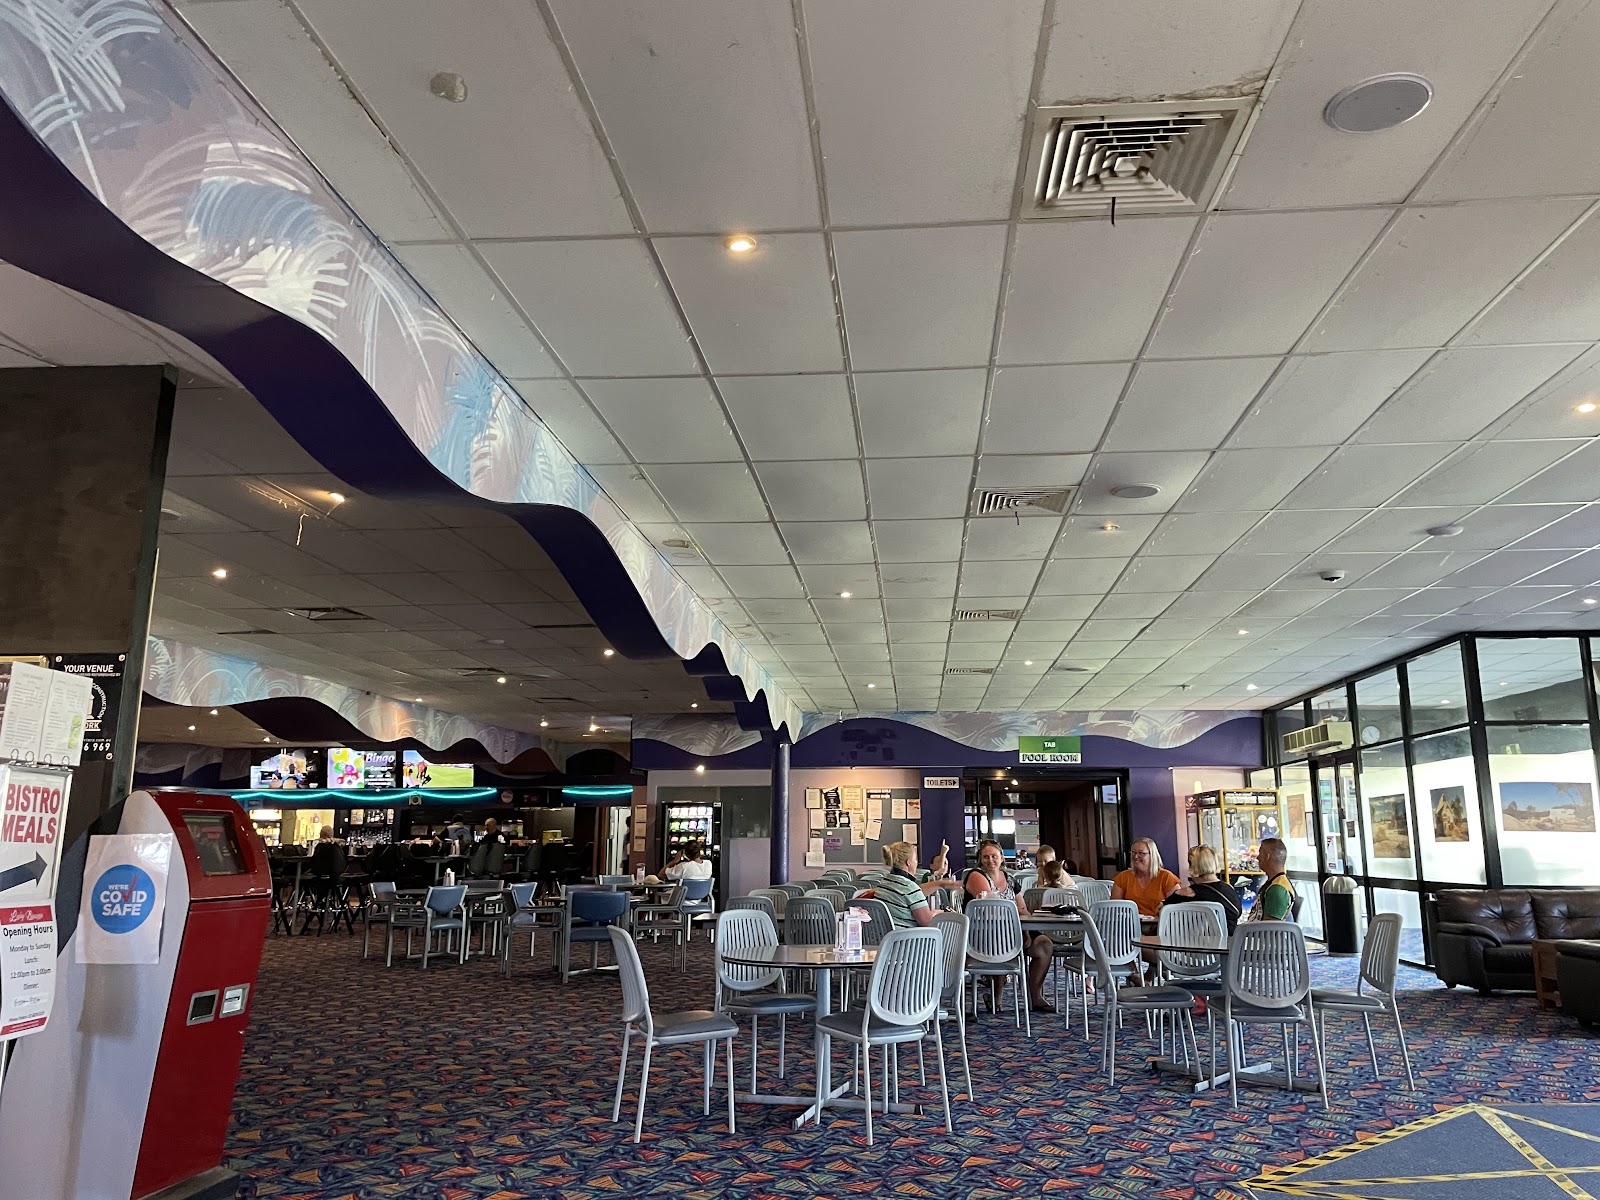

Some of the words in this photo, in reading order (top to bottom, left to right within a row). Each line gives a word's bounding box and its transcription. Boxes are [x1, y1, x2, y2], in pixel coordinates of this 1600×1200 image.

[64, 664, 85, 673] YOUR
[86, 664, 114, 673] VENUE
[92, 742, 111, 751] 969
[366, 752, 395, 765] Bingo
[1021, 753, 1048, 762] POOL
[1049, 753, 1079, 762] ROOM
[5, 783, 61, 815] BISTRO
[0, 814, 57, 844] MEALS
[100, 890, 147, 903] COVID
[102, 903, 142, 916] SAFE
[3, 926, 33, 939] Opening
[33, 924, 54, 935] Hours
[9, 945, 29, 953] Monday
[35, 942, 51, 950] Sunday
